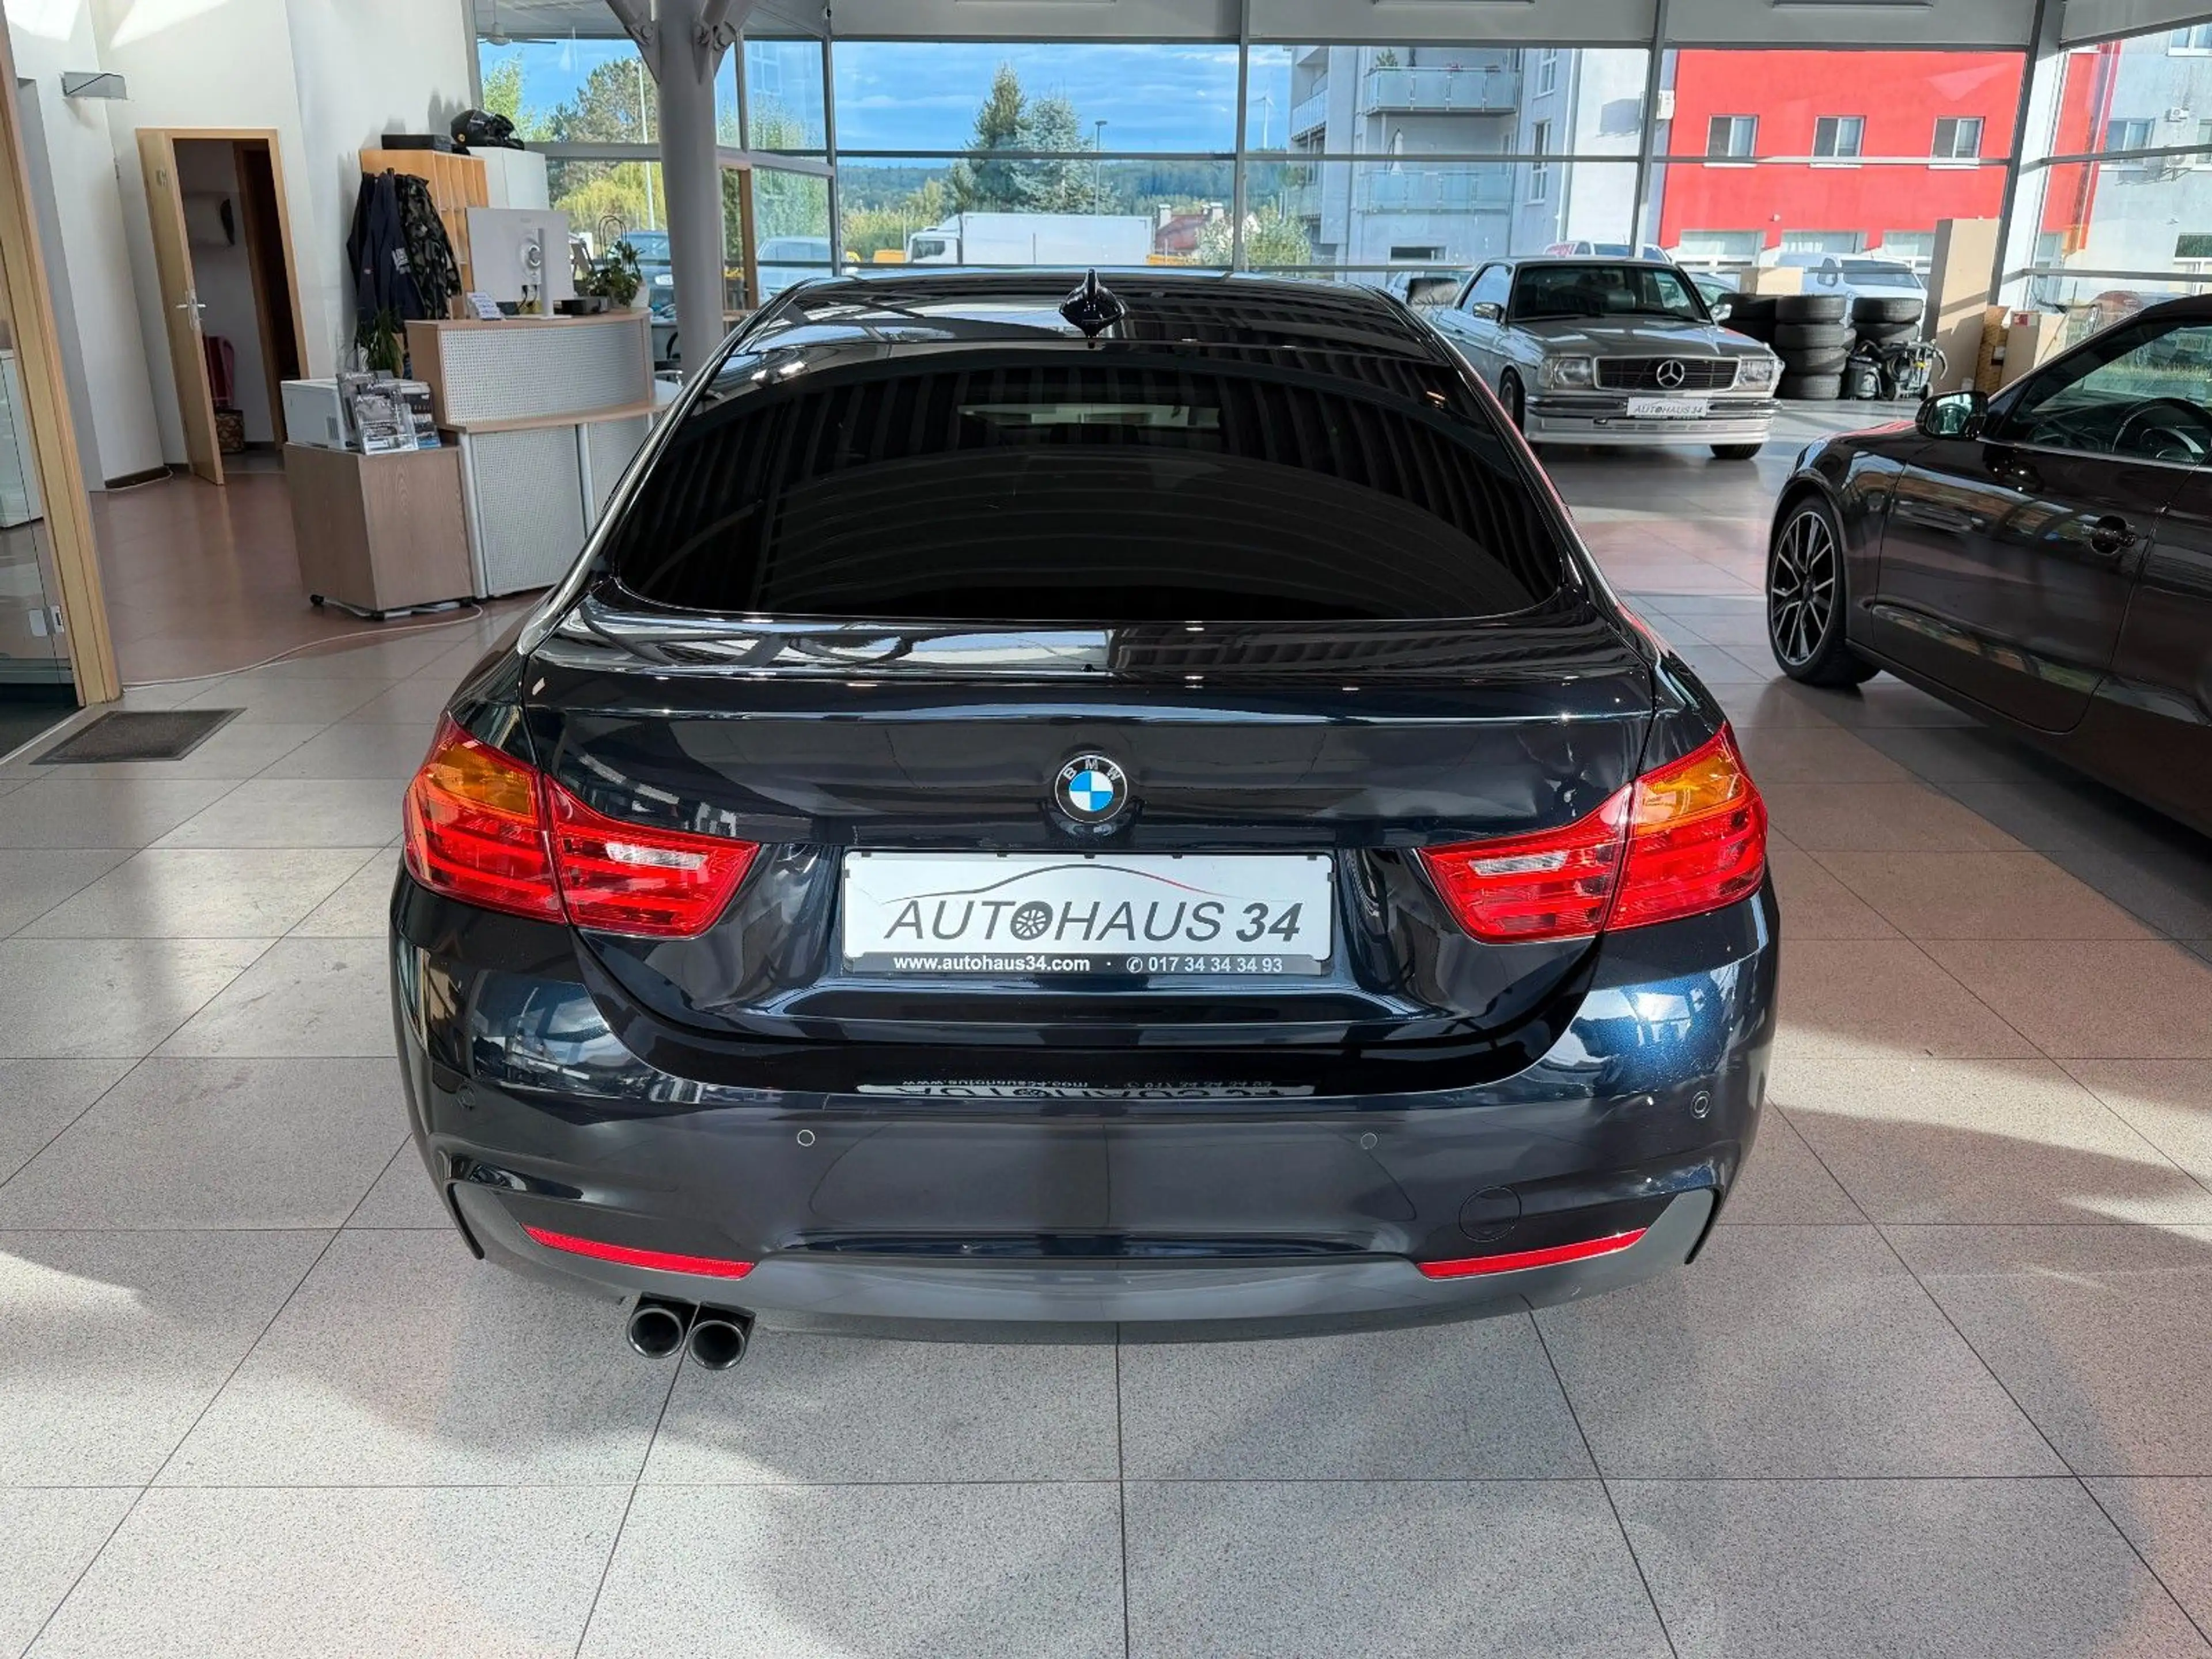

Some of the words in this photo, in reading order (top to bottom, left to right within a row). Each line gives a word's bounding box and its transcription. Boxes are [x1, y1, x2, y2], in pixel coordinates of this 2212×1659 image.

[1063, 758, 1121, 781] BMW
[883, 900, 1225, 941] AUTOHAUS
[1236, 902, 1303, 942] 34
[893, 955, 1090, 971] www.autohaus34.com
[1149, 956, 1179, 972] 017
[1184, 957, 1206, 972] 34
[1211, 957, 1232, 972] 34
[1237, 957, 1257, 973] 34
[1262, 957, 1283, 973] 93
